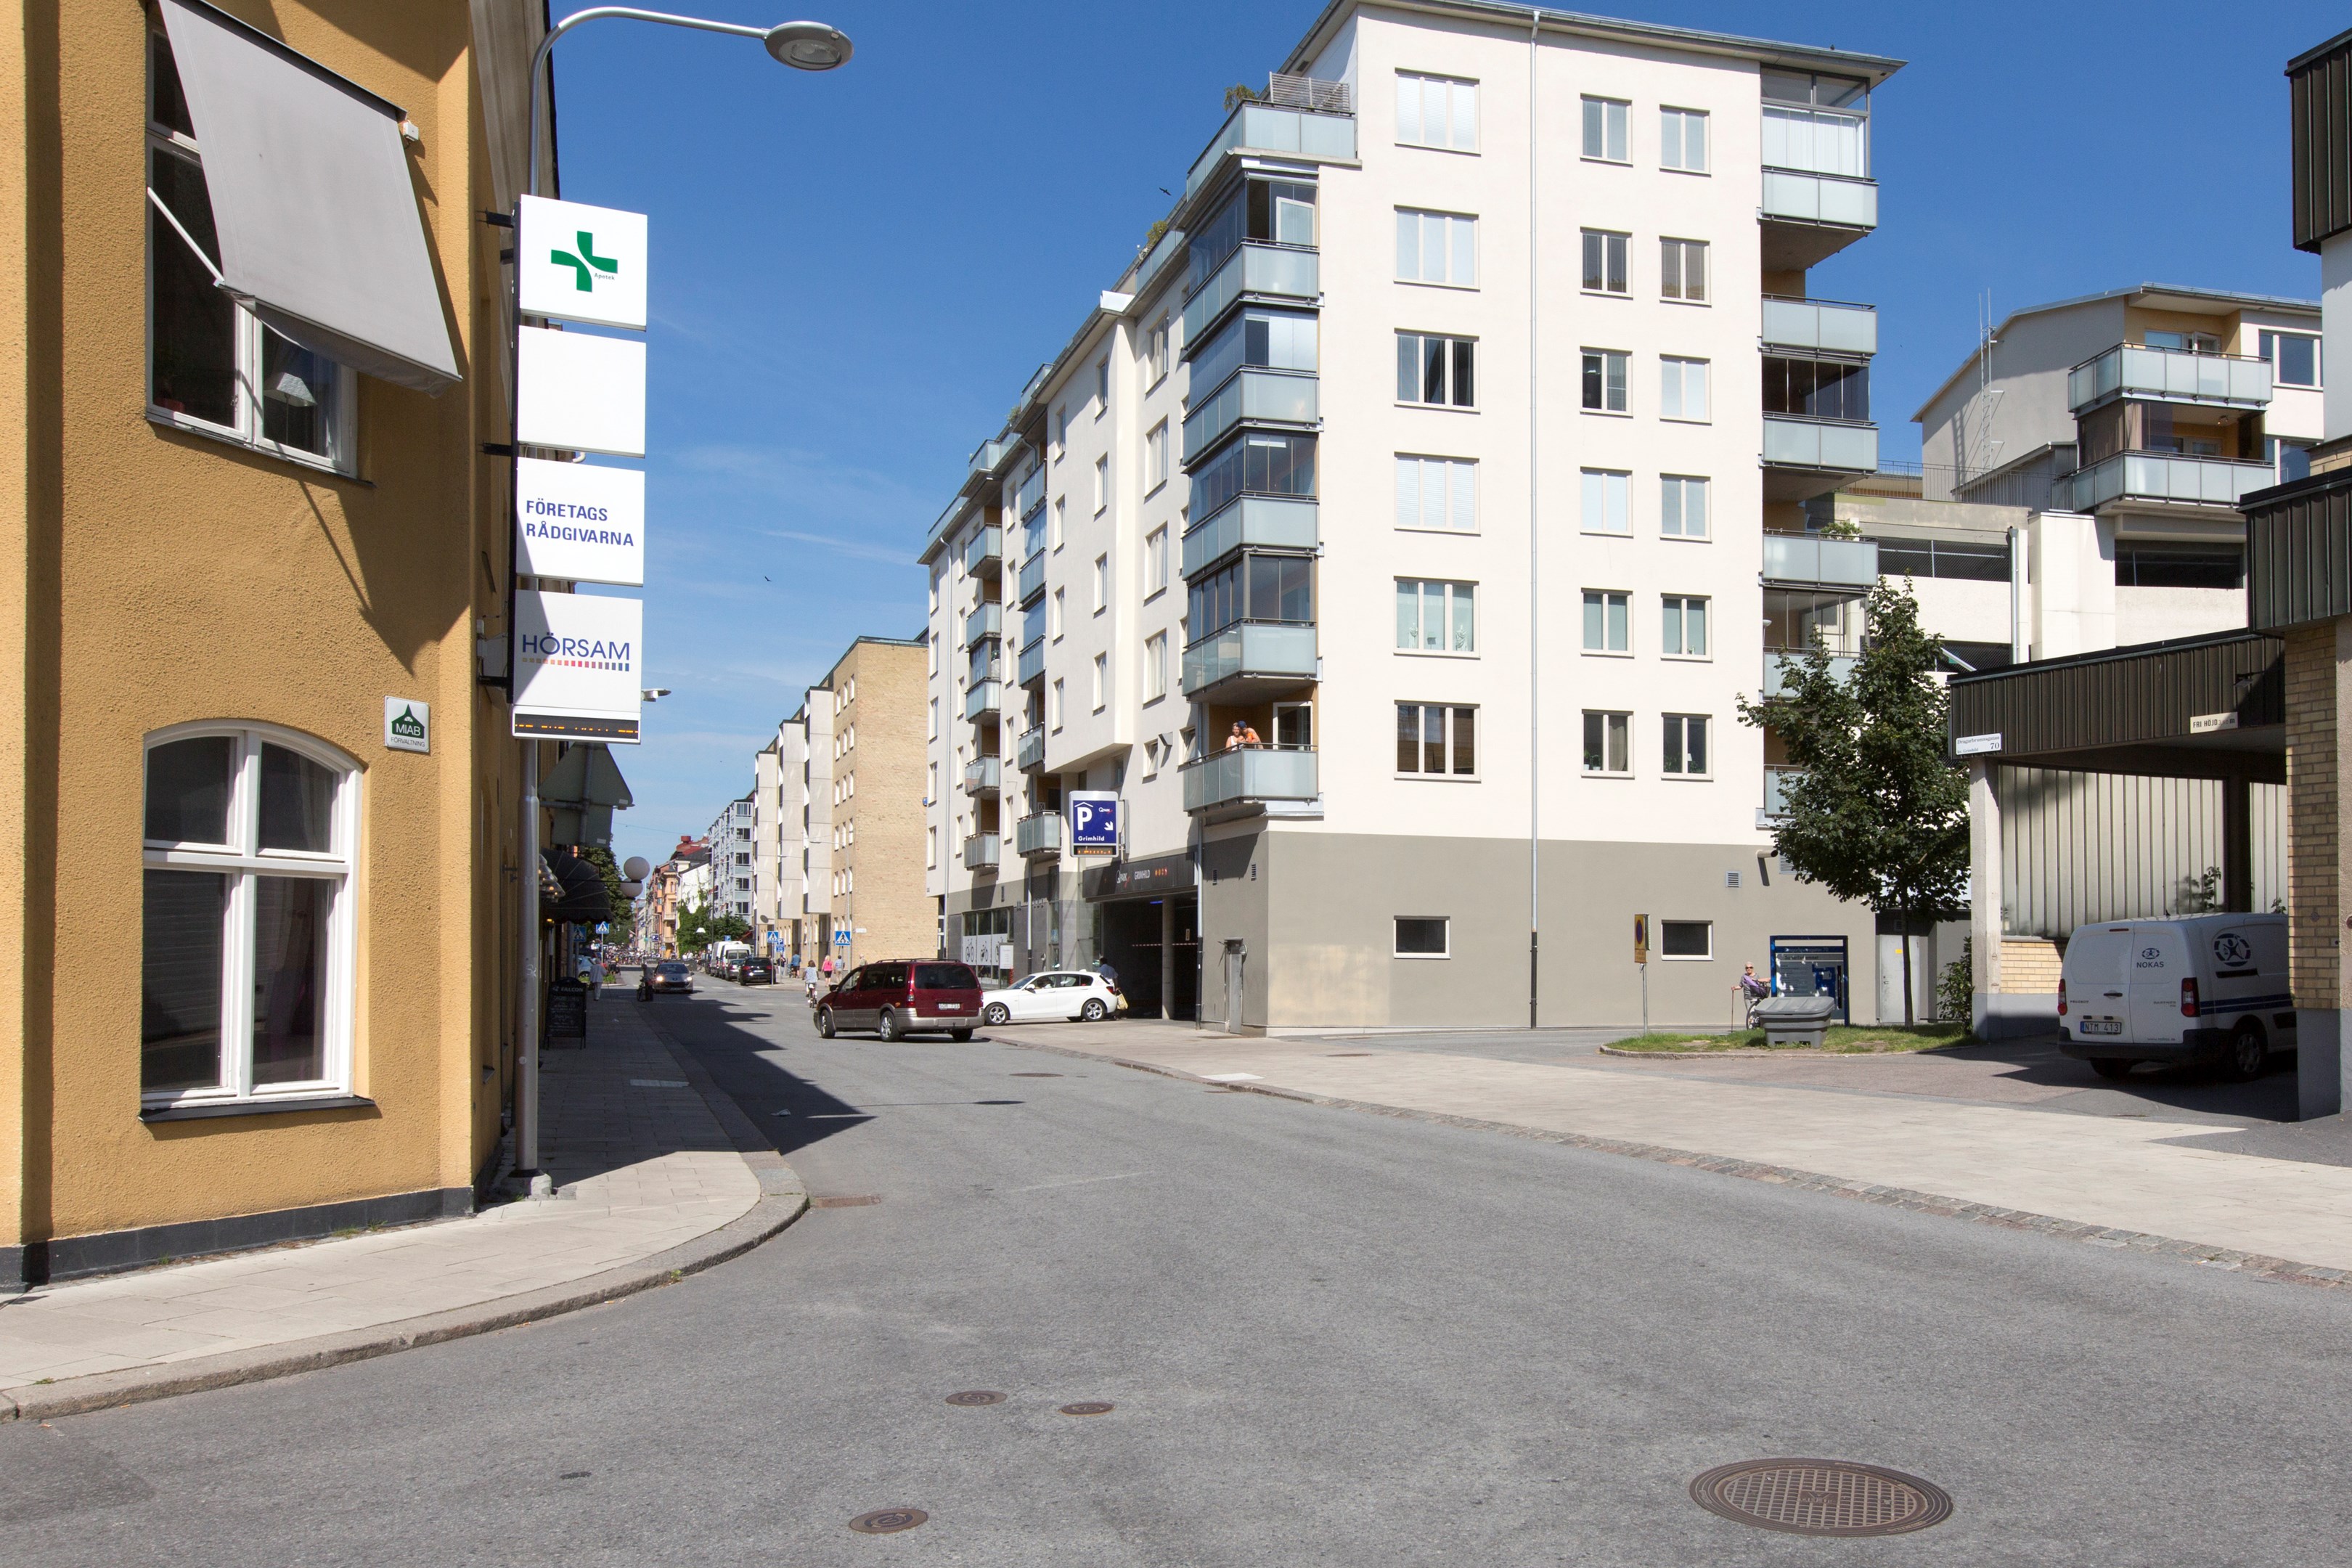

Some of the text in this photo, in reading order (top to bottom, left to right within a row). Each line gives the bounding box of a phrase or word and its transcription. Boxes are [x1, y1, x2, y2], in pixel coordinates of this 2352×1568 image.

[594, 272, 616, 281] Apotek
[526, 497, 608, 522] FÖRETAGS
[526, 520, 634, 547] RÅDGIVARNA
[522, 632, 630, 661] HÖRSAM
[396, 723, 421, 736] MIAB
[2204, 718, 2218, 727] HÖJD
[391, 737, 425, 747] FÖRVALTNING
[1077, 807, 1093, 830] P
